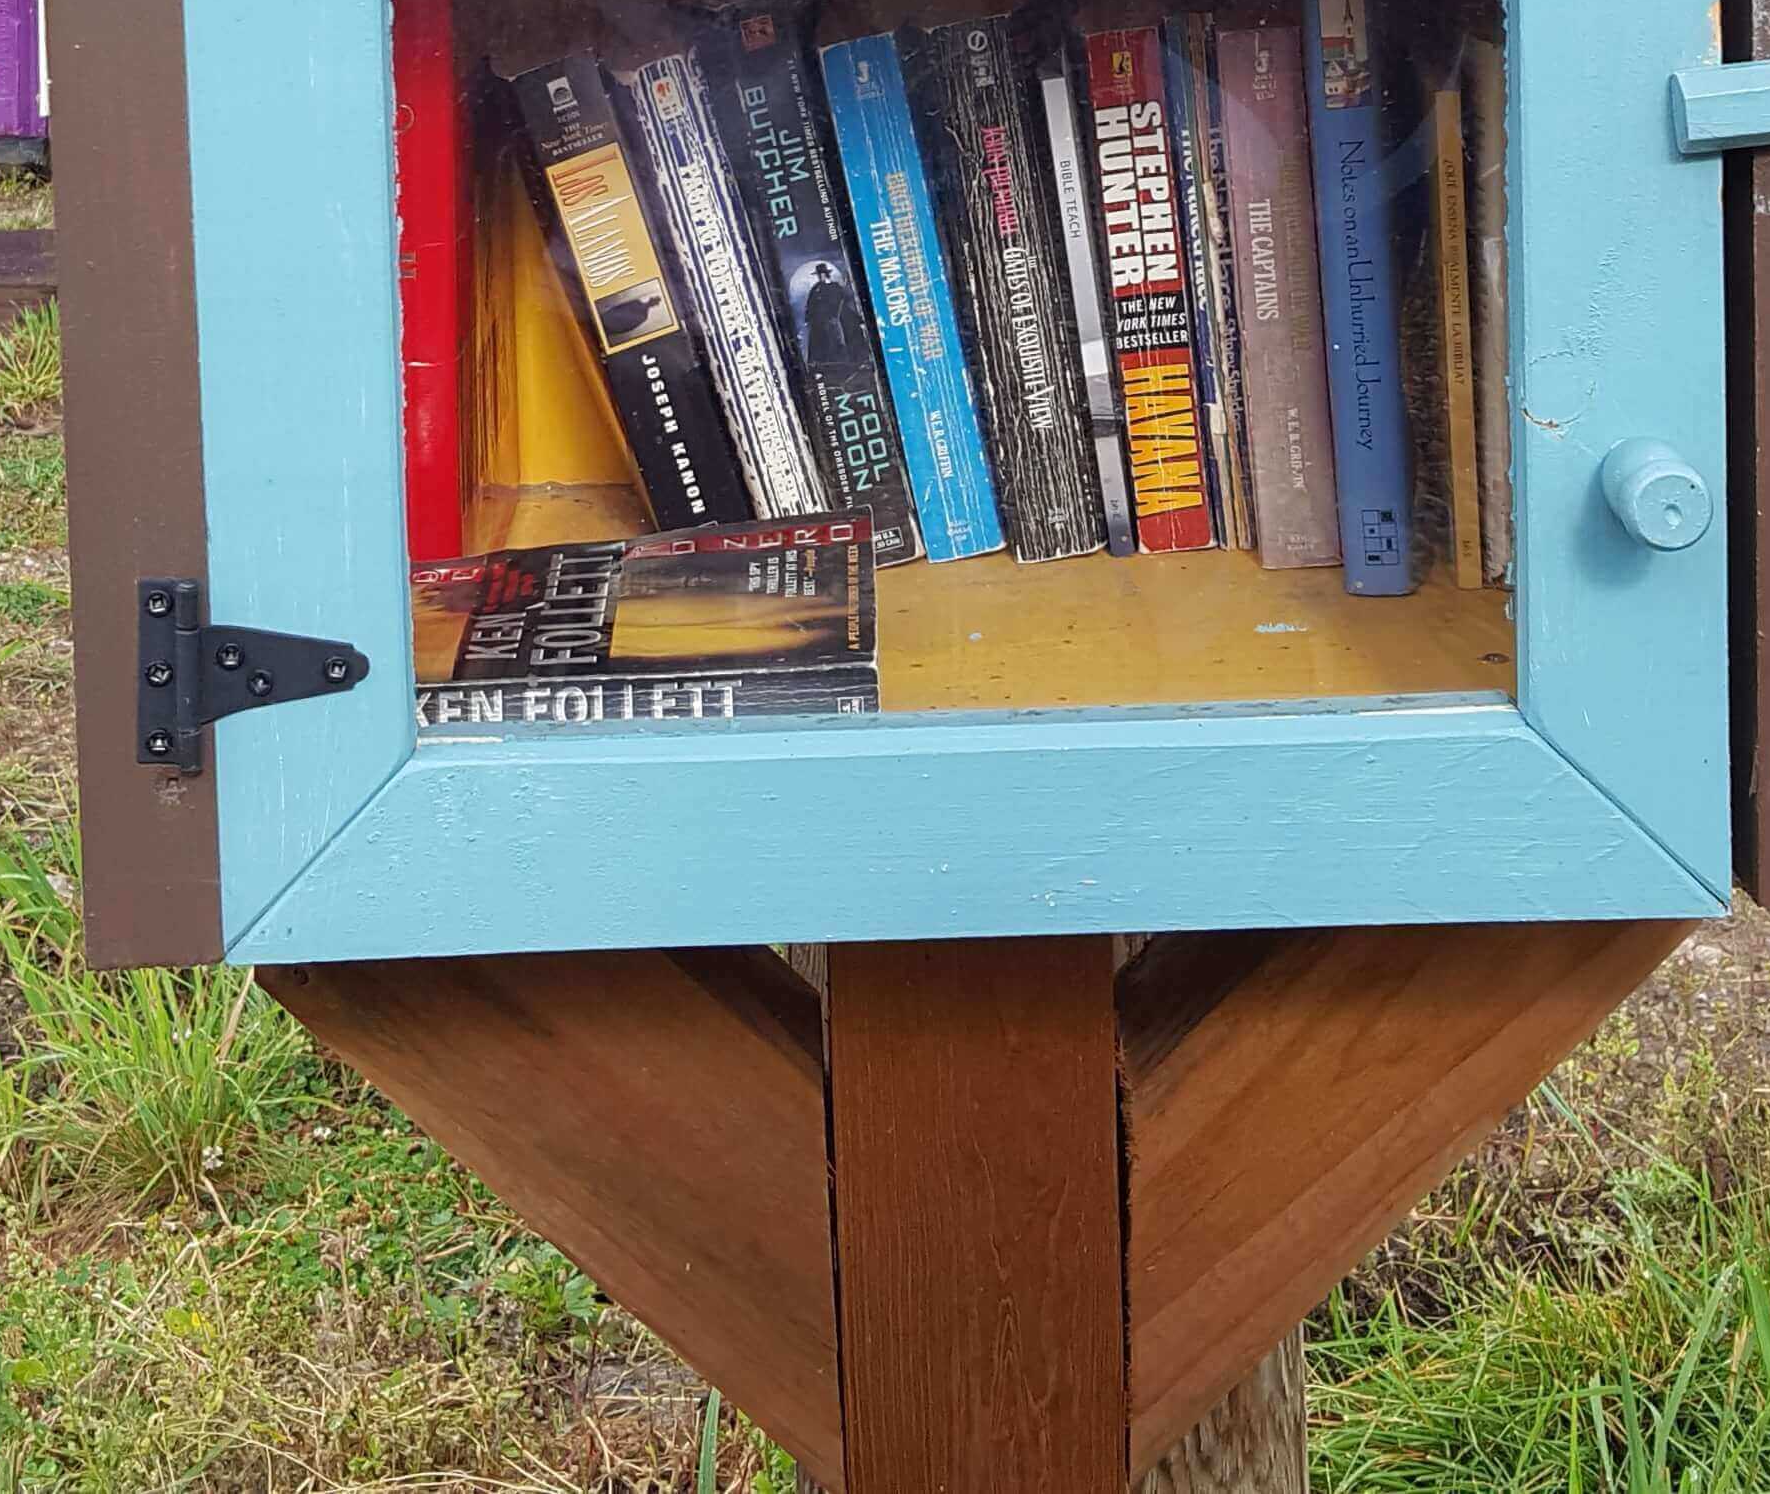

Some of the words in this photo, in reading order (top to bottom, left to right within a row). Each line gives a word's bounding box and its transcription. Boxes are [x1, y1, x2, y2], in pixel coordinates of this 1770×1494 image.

[744, 85, 798, 240] BUTCHER
[779, 129, 811, 183] JIM
[1060, 159, 1074, 194] BIBLE
[1339, 139, 1365, 202] Notes
[1094, 106, 1144, 288] HUNTER
[1129, 100, 1179, 283] STEPHEN
[823, 206, 838, 241] AUTHOR
[870, 217, 897, 254] THE
[1066, 201, 1081, 239] TEACH
[1248, 198, 1273, 234] THE
[1342, 206, 1357, 233] on
[1002, 245, 1033, 291] GATES
[1345, 234, 1360, 259] an
[878, 256, 913, 327] MAJORS
[1009, 291, 1033, 310] OF
[1251, 235, 1279, 321] CAPTAINS
[1117, 316, 1146, 333] YORK
[1150, 312, 1186, 329] TIMES
[1121, 300, 1143, 314] THE
[1149, 295, 1176, 313] NEW
[1348, 259, 1379, 367] Unhurried
[916, 316, 944, 362] WAR
[1010, 314, 1047, 391] EXQUISITE
[1116, 329, 1189, 350] BESTSELLER
[1452, 322, 1463, 340] LA
[817, 382, 829, 413] NOVEL
[828, 429, 839, 447] THE
[1021, 384, 1059, 431] VIEW
[1356, 368, 1381, 451] Journey
[641, 353, 679, 433] JOSEPH
[671, 441, 706, 514] KANON
[834, 392, 873, 491] MOON
[857, 393, 890, 483] FOOL
[1123, 363, 1204, 520] HAVANA
[724, 522, 855, 550] ZERO
[785, 572, 798, 598] FOLLETT
[530, 553, 614, 666] FOLLETT
[464, 611, 528, 661] KEN
